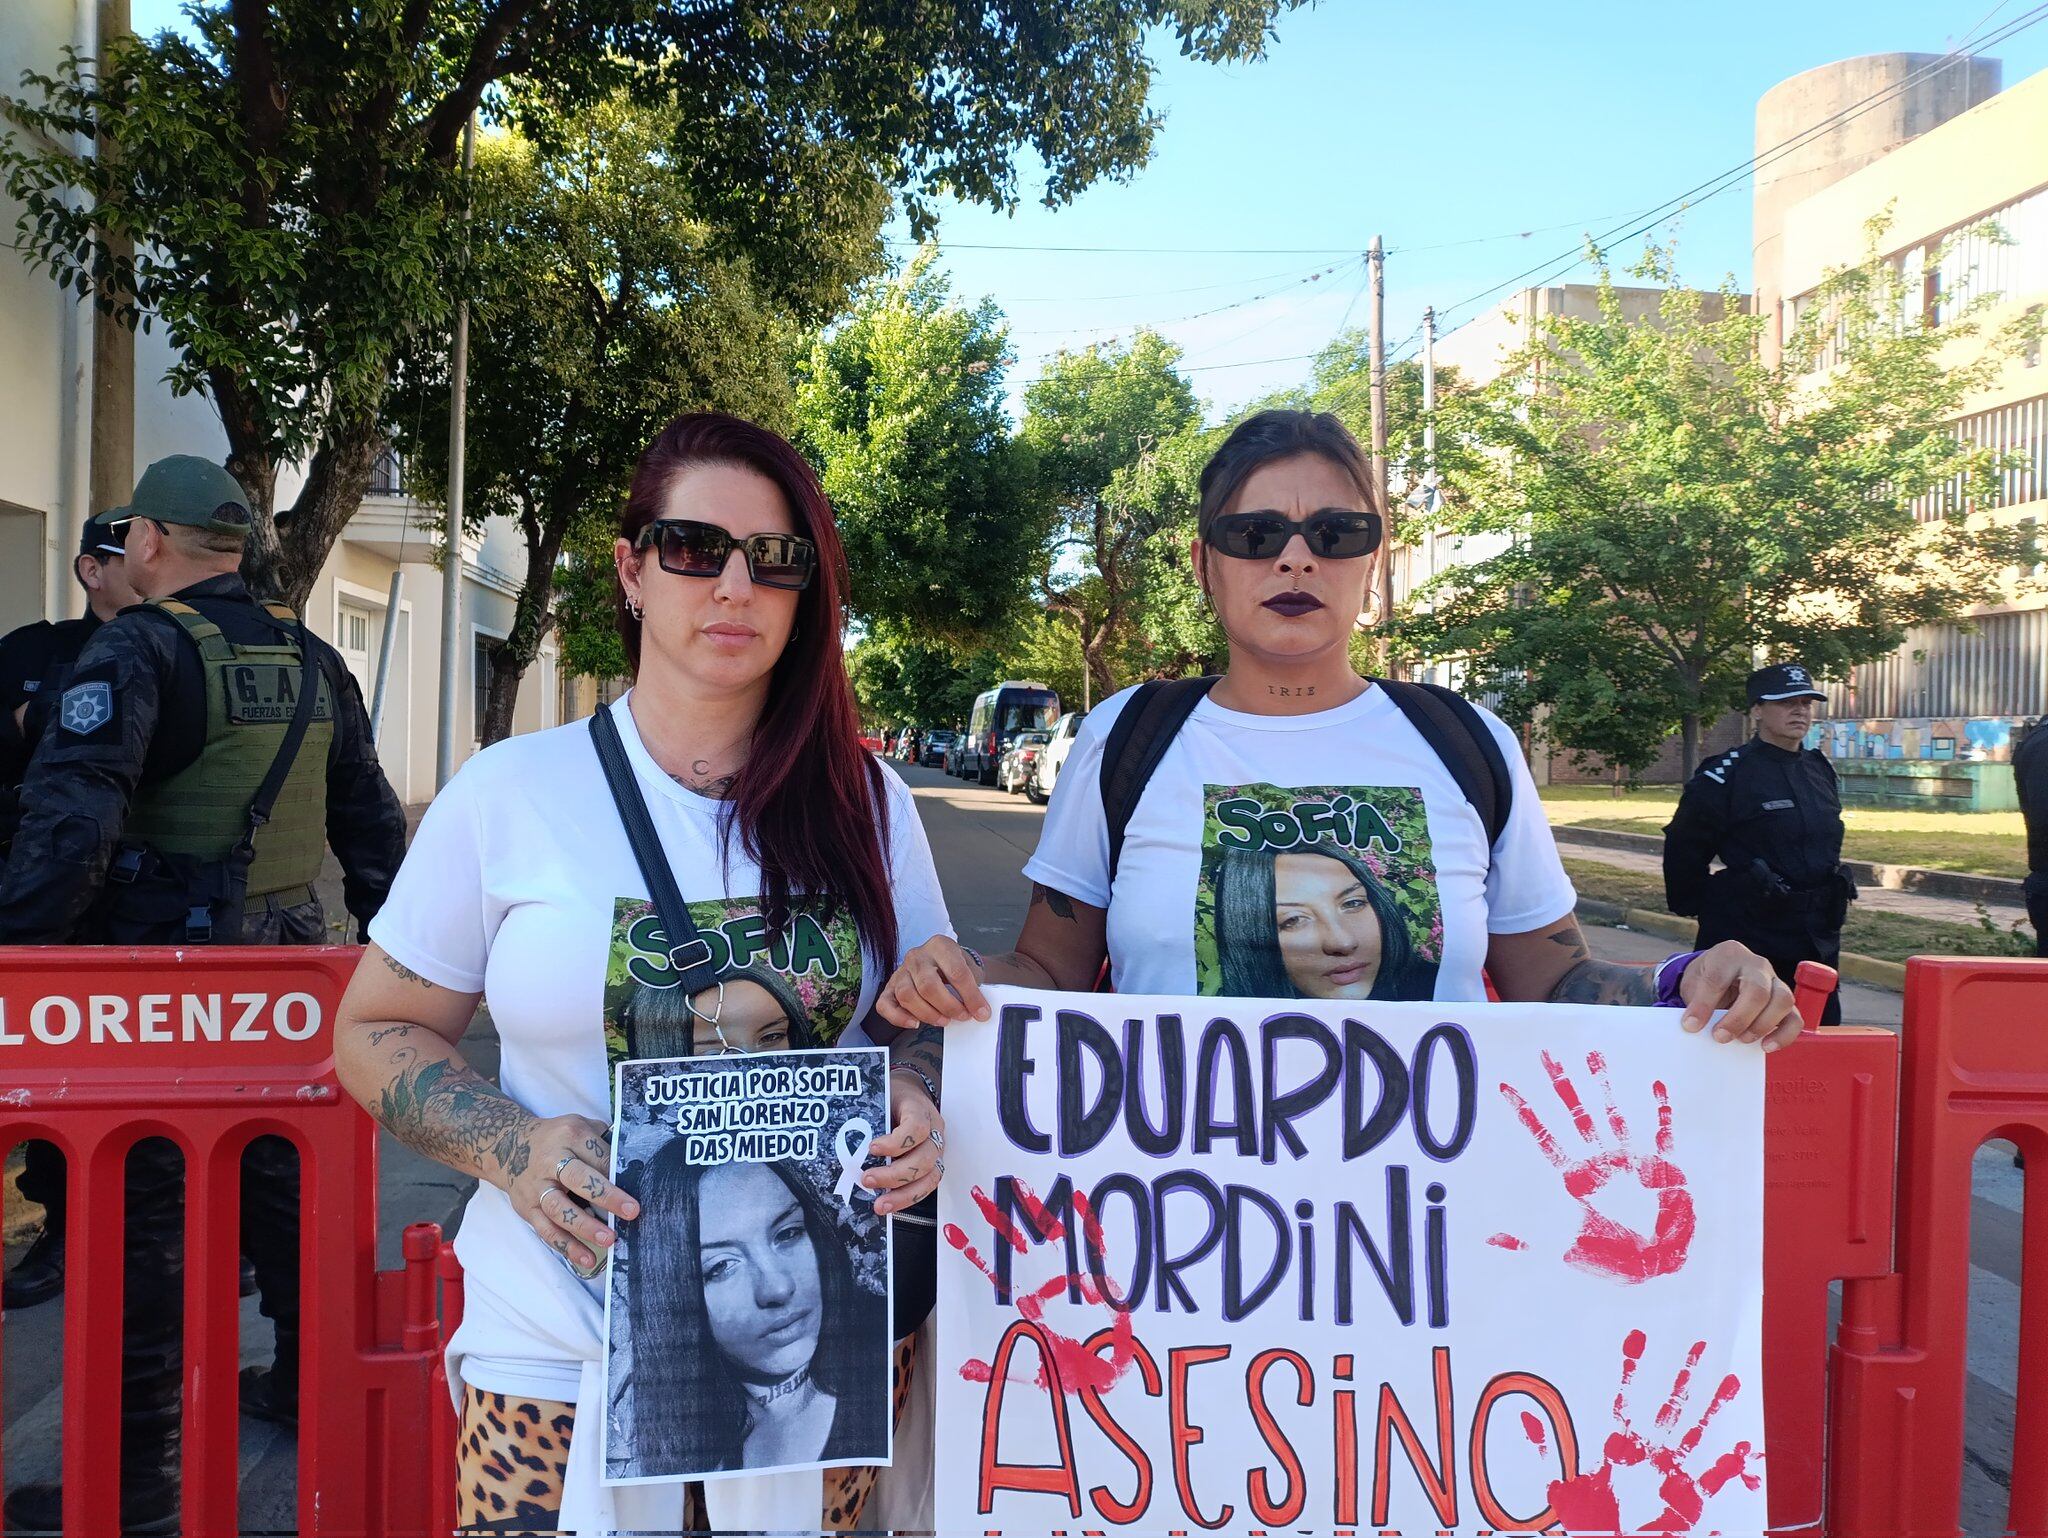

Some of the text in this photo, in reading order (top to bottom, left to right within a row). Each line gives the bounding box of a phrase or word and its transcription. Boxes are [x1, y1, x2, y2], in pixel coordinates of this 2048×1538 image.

[1268, 685, 1316, 697] IRIE
[241, 707, 281, 718] FUERZAS
[0, 991, 322, 1046] LORENZO
[648, 1068, 859, 1102] JUSTICIA POR SOFIA
[994, 1003, 1479, 1166] EDUARDO
[680, 1101, 826, 1131] SAN LORENZO
[688, 1132, 815, 1162] DAS MIEDO!
